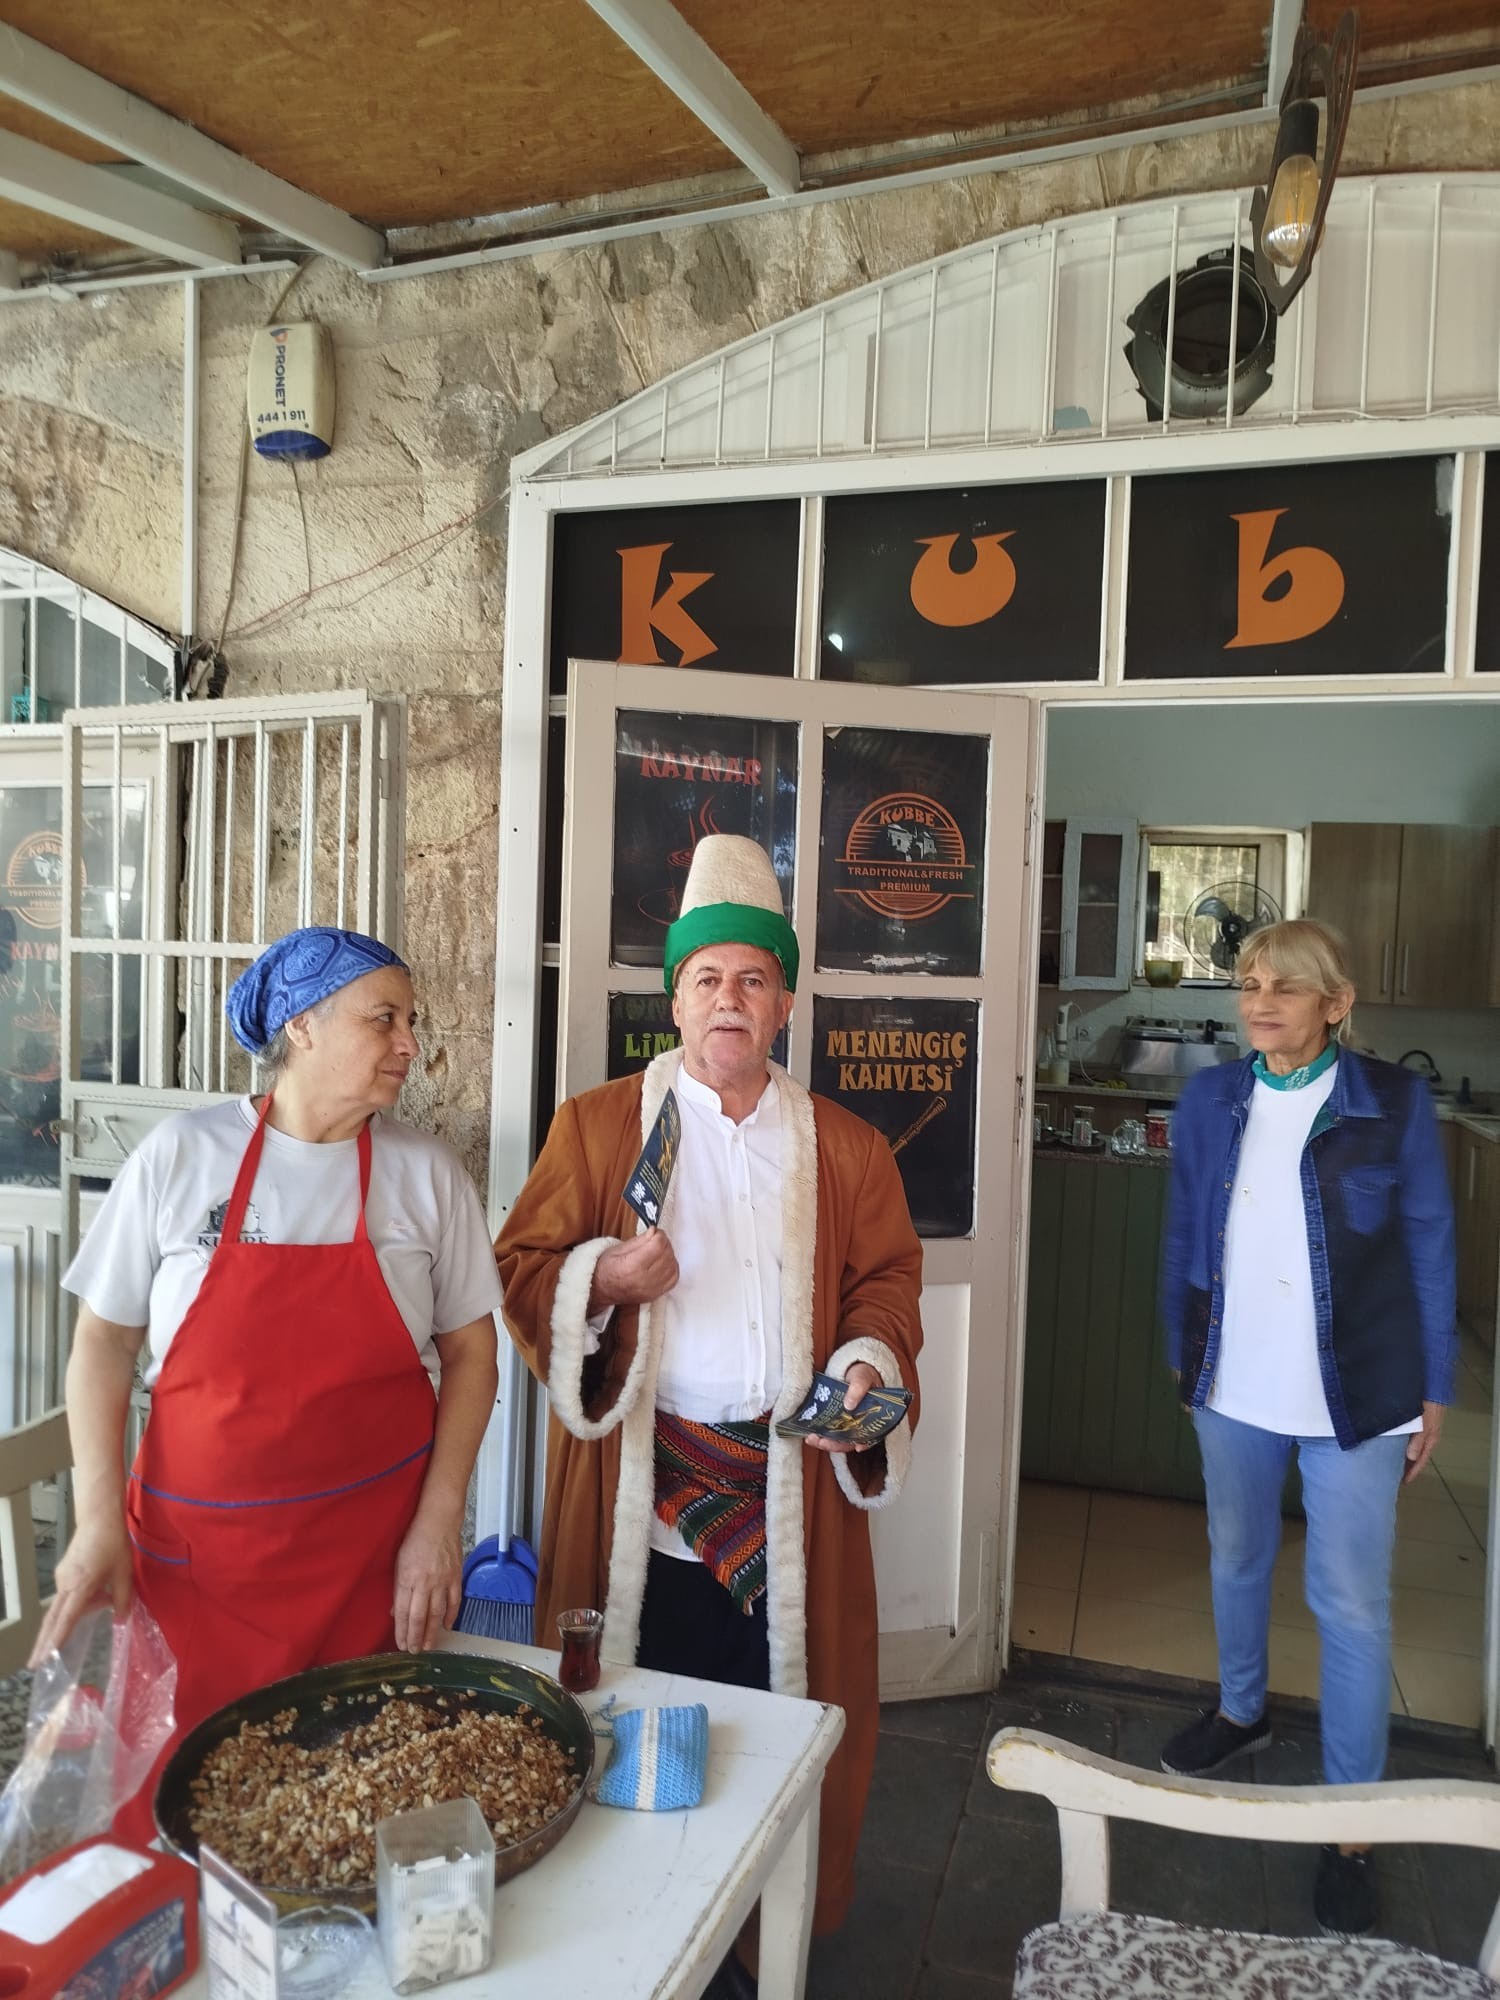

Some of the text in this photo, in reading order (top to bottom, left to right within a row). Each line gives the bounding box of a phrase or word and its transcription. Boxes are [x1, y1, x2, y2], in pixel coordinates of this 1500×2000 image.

[275, 345, 286, 407] PRONET
[257, 411, 279, 424] 444
[289, 410, 306, 421] 911
[640, 751, 762, 785] KAYNAR
[880, 882, 931, 892] PREMIUM
